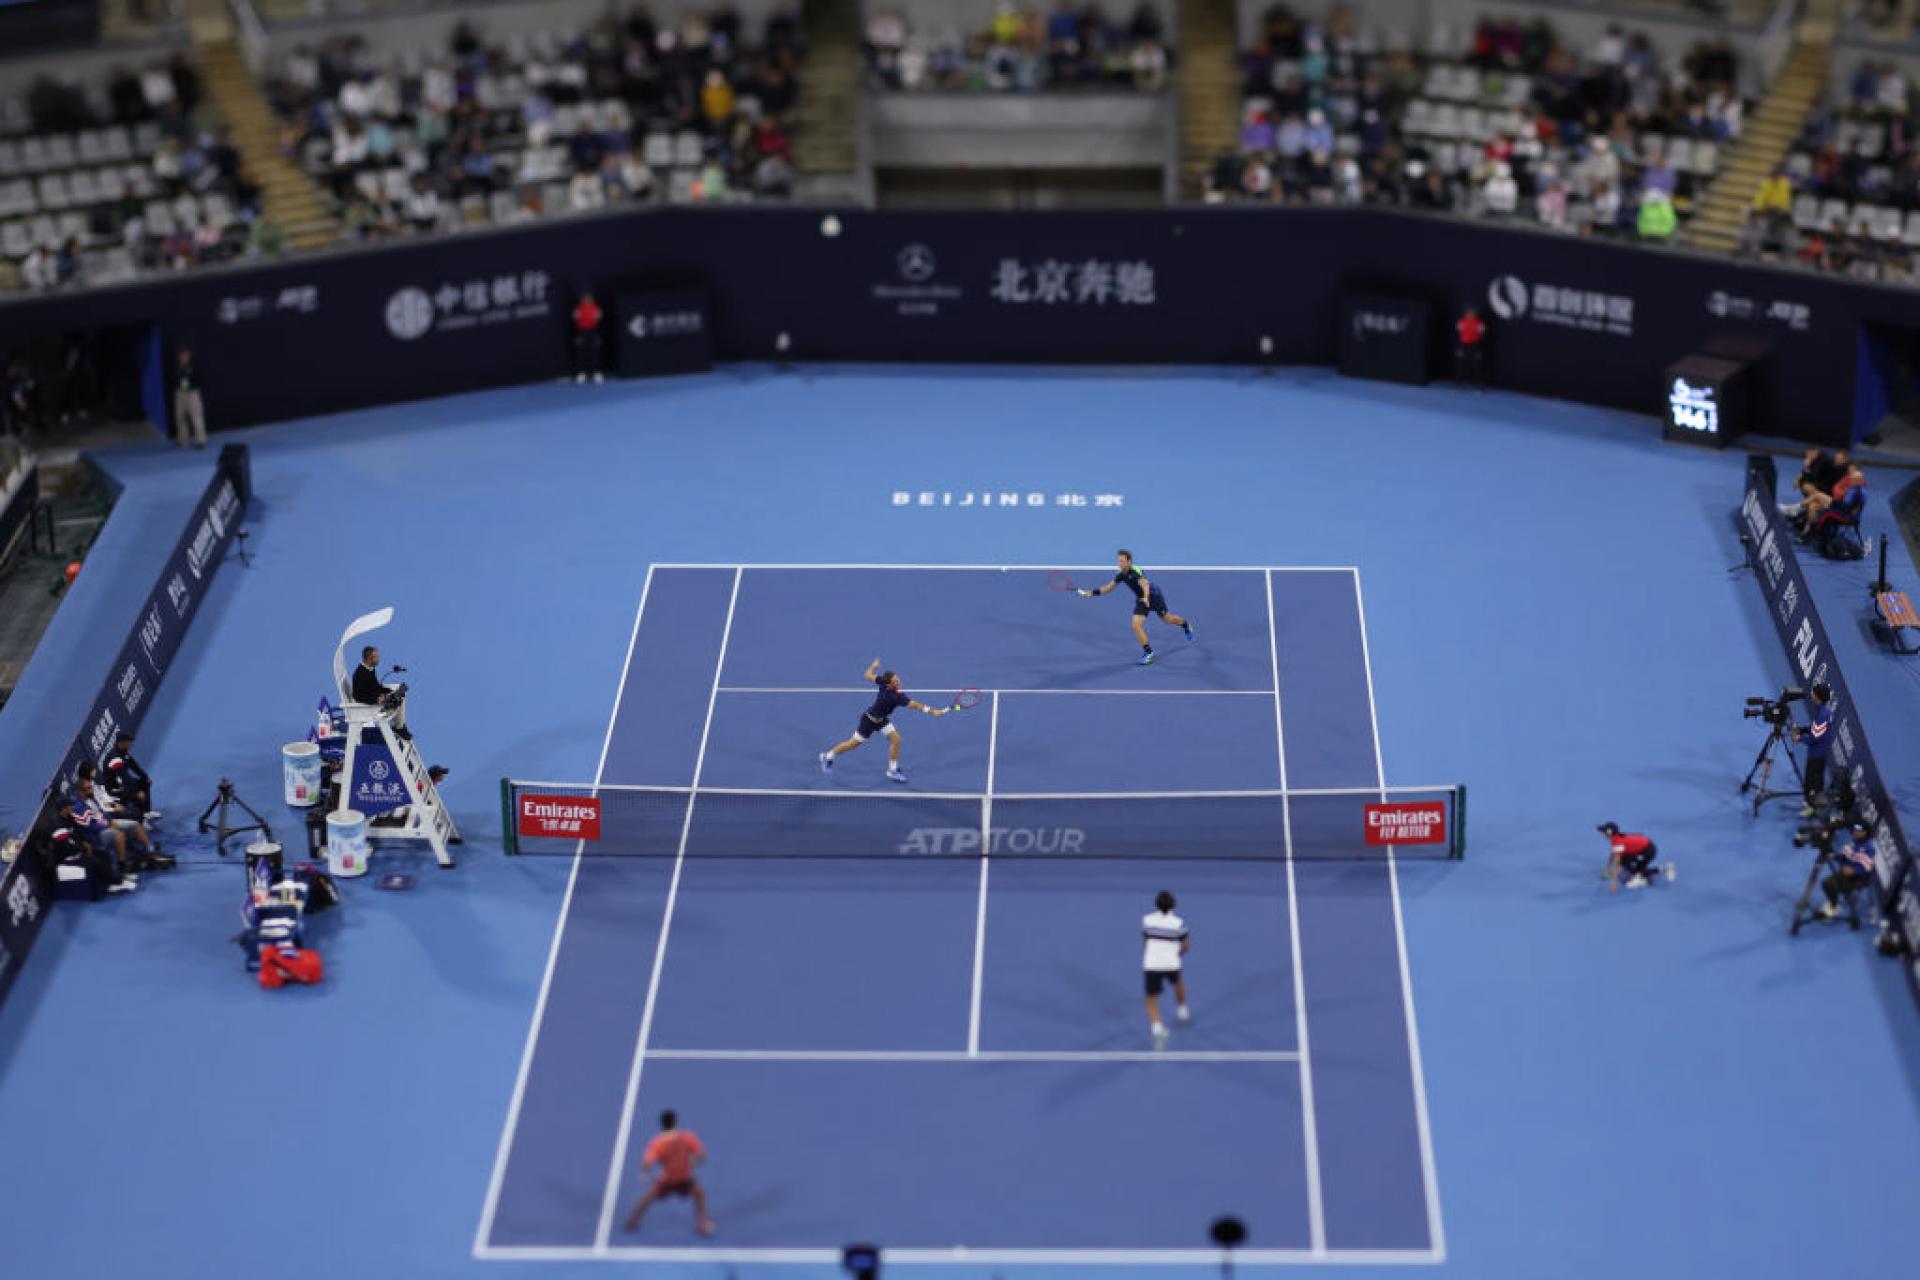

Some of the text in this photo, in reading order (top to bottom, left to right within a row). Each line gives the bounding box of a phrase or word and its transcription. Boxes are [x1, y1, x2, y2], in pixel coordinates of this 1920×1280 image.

[990, 258, 1156, 305] 北京奔驰
[892, 491, 1124, 507] BEIJING 北京
[523, 801, 597, 820] Emirates
[1368, 809, 1441, 827] Emirates
[899, 827, 1087, 855] ATP TOUR
